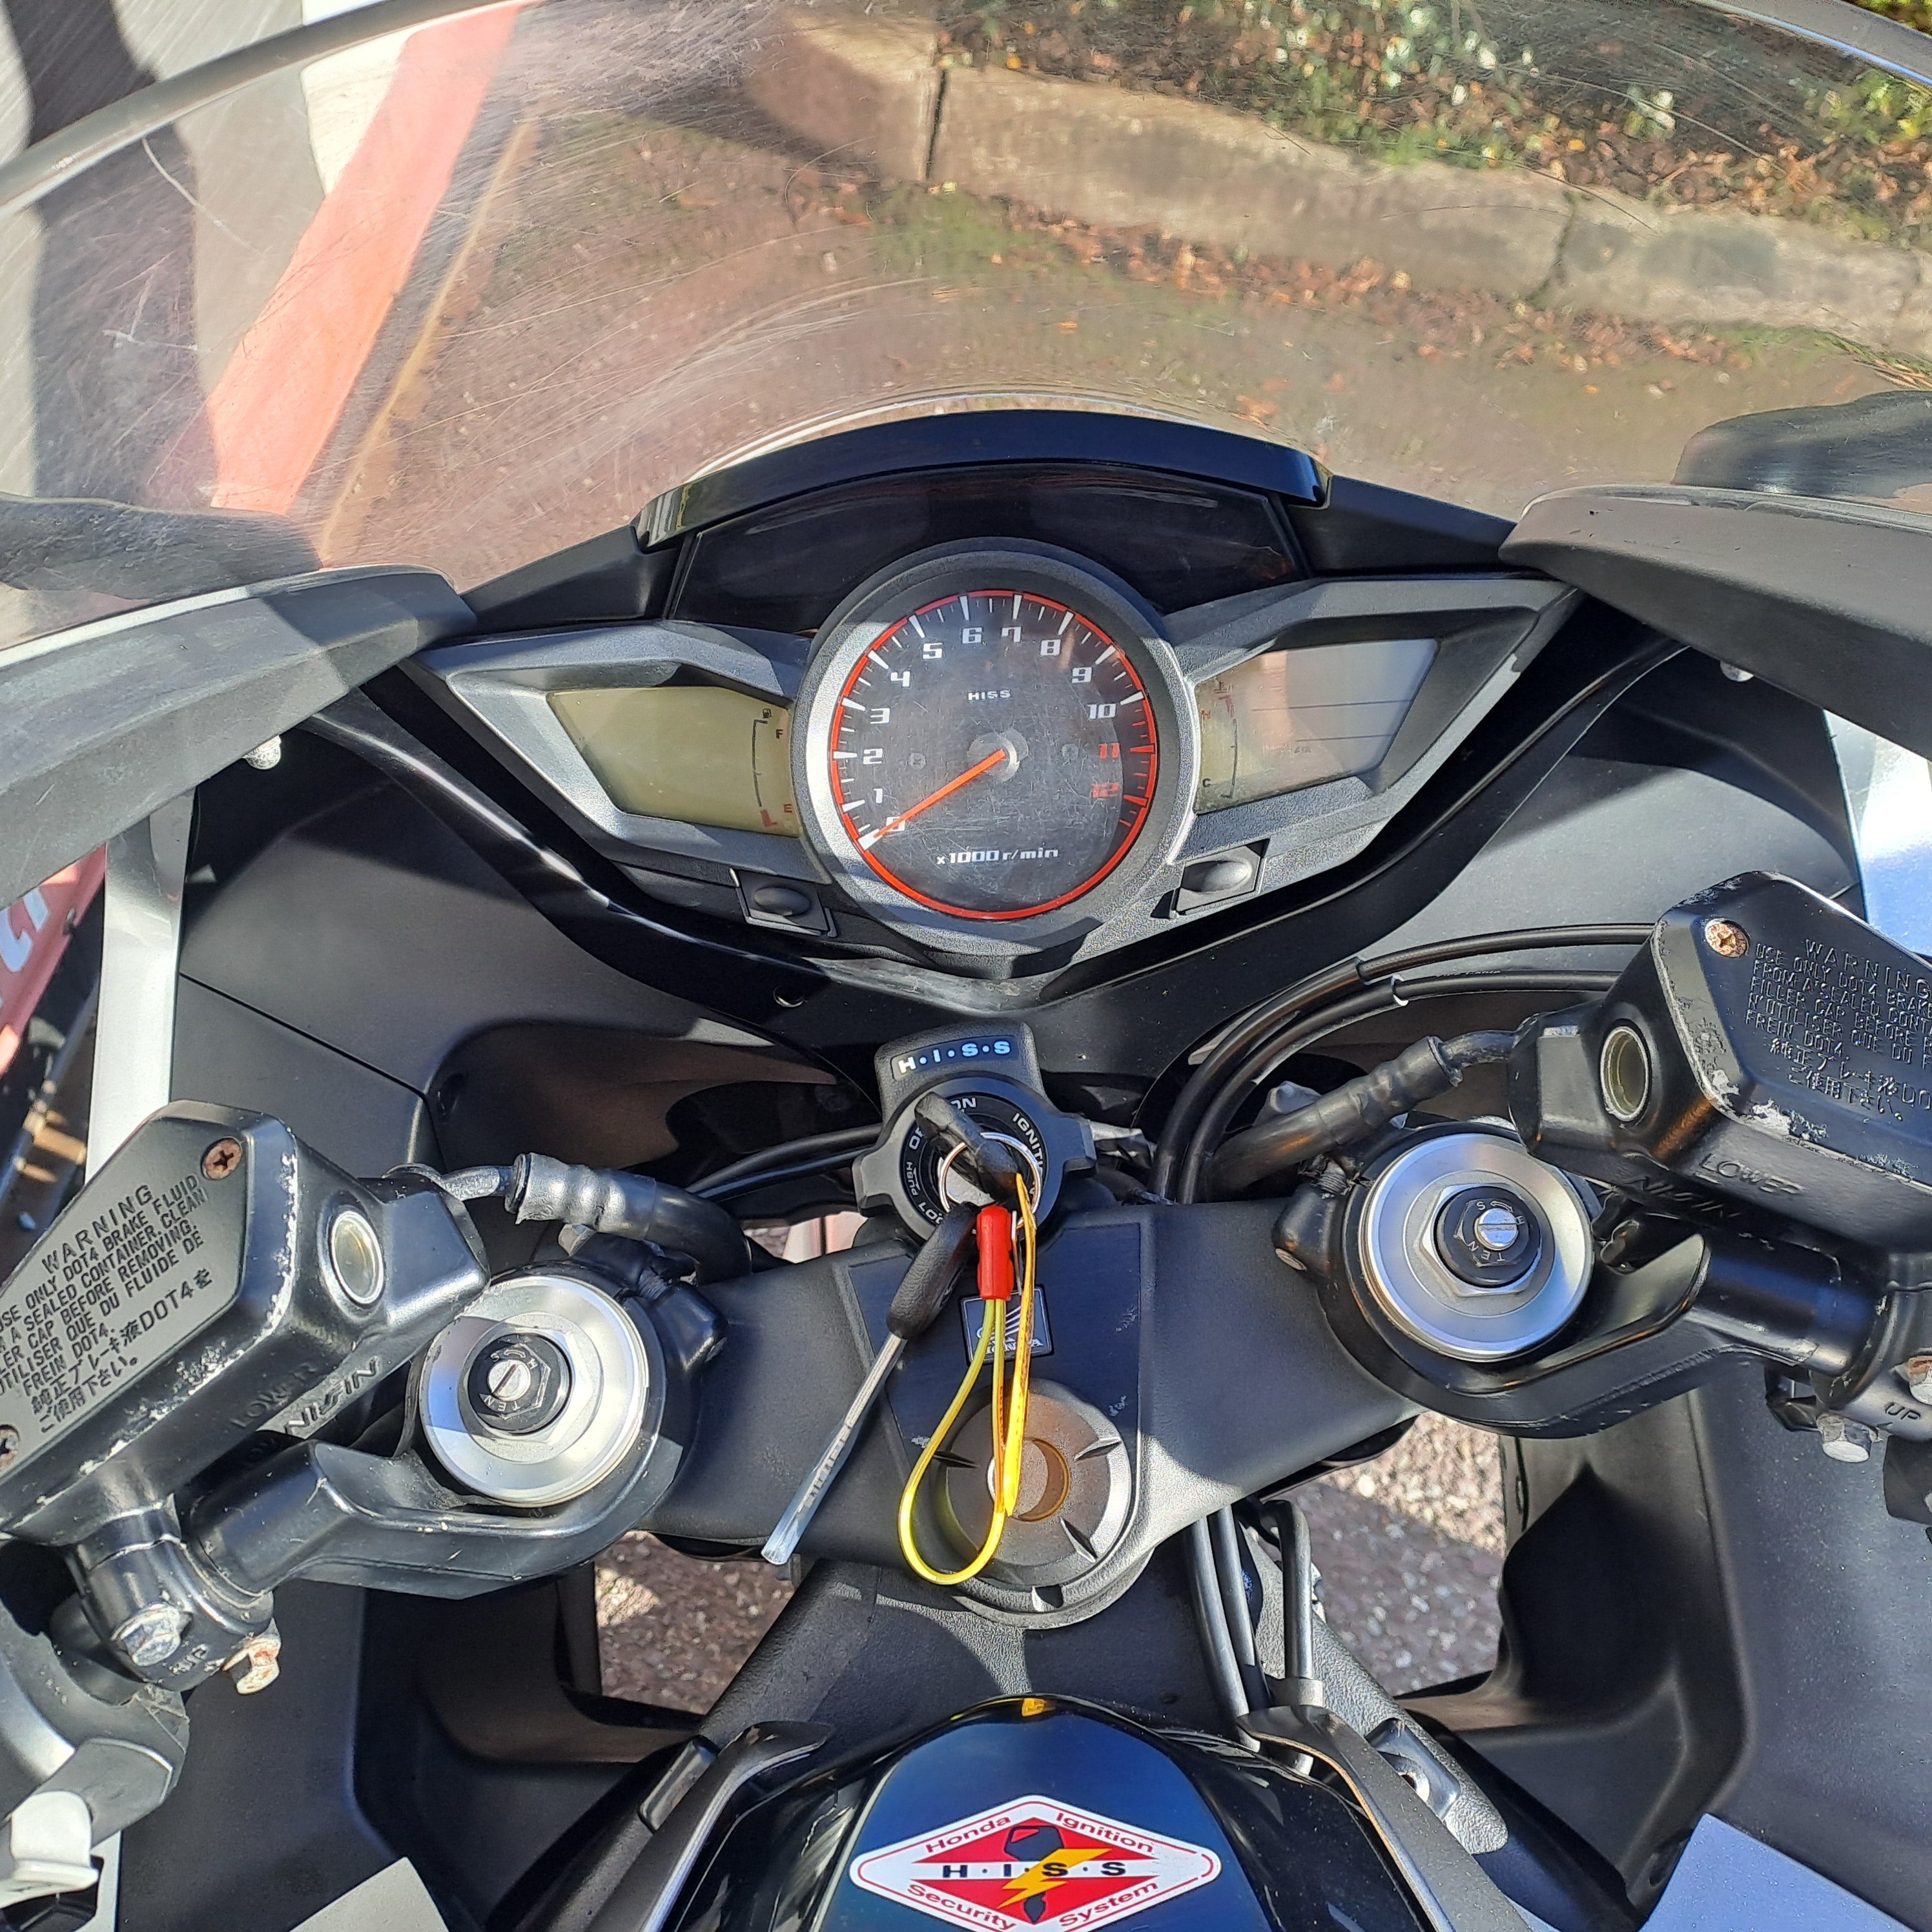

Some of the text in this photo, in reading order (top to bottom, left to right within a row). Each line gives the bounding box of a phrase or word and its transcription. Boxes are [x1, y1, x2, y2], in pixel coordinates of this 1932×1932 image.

[961, 627, 983, 644] 6
[1002, 626, 1022, 642] 7
[923, 643, 943, 659] 5
[1040, 639, 1061, 656] 8
[890, 671, 911, 687] 4
[1072, 667, 1093, 683] 9
[968, 689, 1011, 701] HISS
[870, 708, 890, 724] 3
[1087, 703, 1116, 719] 10
[863, 748, 883, 765] 2
[1098, 742, 1120, 759] 11
[1202, 778, 1211, 788] C
[873, 788, 883, 803] 1
[783, 804, 792, 813] E
[885, 816, 905, 831] 0
[1756, 943, 1785, 966] USE
[1793, 956, 1831, 982] ONLY
[1838, 971, 1878, 999] DOT4
[1805, 939, 1931, 1000] WARNING
[1753, 959, 1798, 989] FROM
[1819, 982, 1880, 1018] SEALED
[1751, 975, 1806, 1009] FILLER
[1814, 999, 1846, 1020] CAP
[1854, 1011, 1915, 1047] BEFORE
[1745, 1009, 1794, 1040] FREIN
[906, 1162, 919, 1196] PUSH
[42, 1184, 152, 1274] WARNING
[25, 1275, 58, 1310] ONLY
[63, 1247, 99, 1282] DOT4
[102, 1211, 149, 1253] BRAKE
[152, 1174, 200, 1215] FLUID
[24, 1284, 77, 1331] SEALED
[81, 1225, 163, 1289] CONTAINER.
[159, 1187, 209, 1229] CLEAN
[28, 1320, 55, 1350] CAP
[60, 1277, 115, 1326] BEFORE
[118, 1219, 198, 1283] REMOVING.
[66, 1311, 96, 1342] QUE
[99, 1292, 121, 1317] DU
[124, 1249, 180, 1299] FLUIDE
[182, 1229, 205, 1255] DE
[23, 1322, 116, 1397] FREIN DOT4.
[1884, 1401, 1922, 1421] UP
[925, 1812, 1154, 1853] Honda Ignition
[907, 1880, 1159, 1931] Security System
